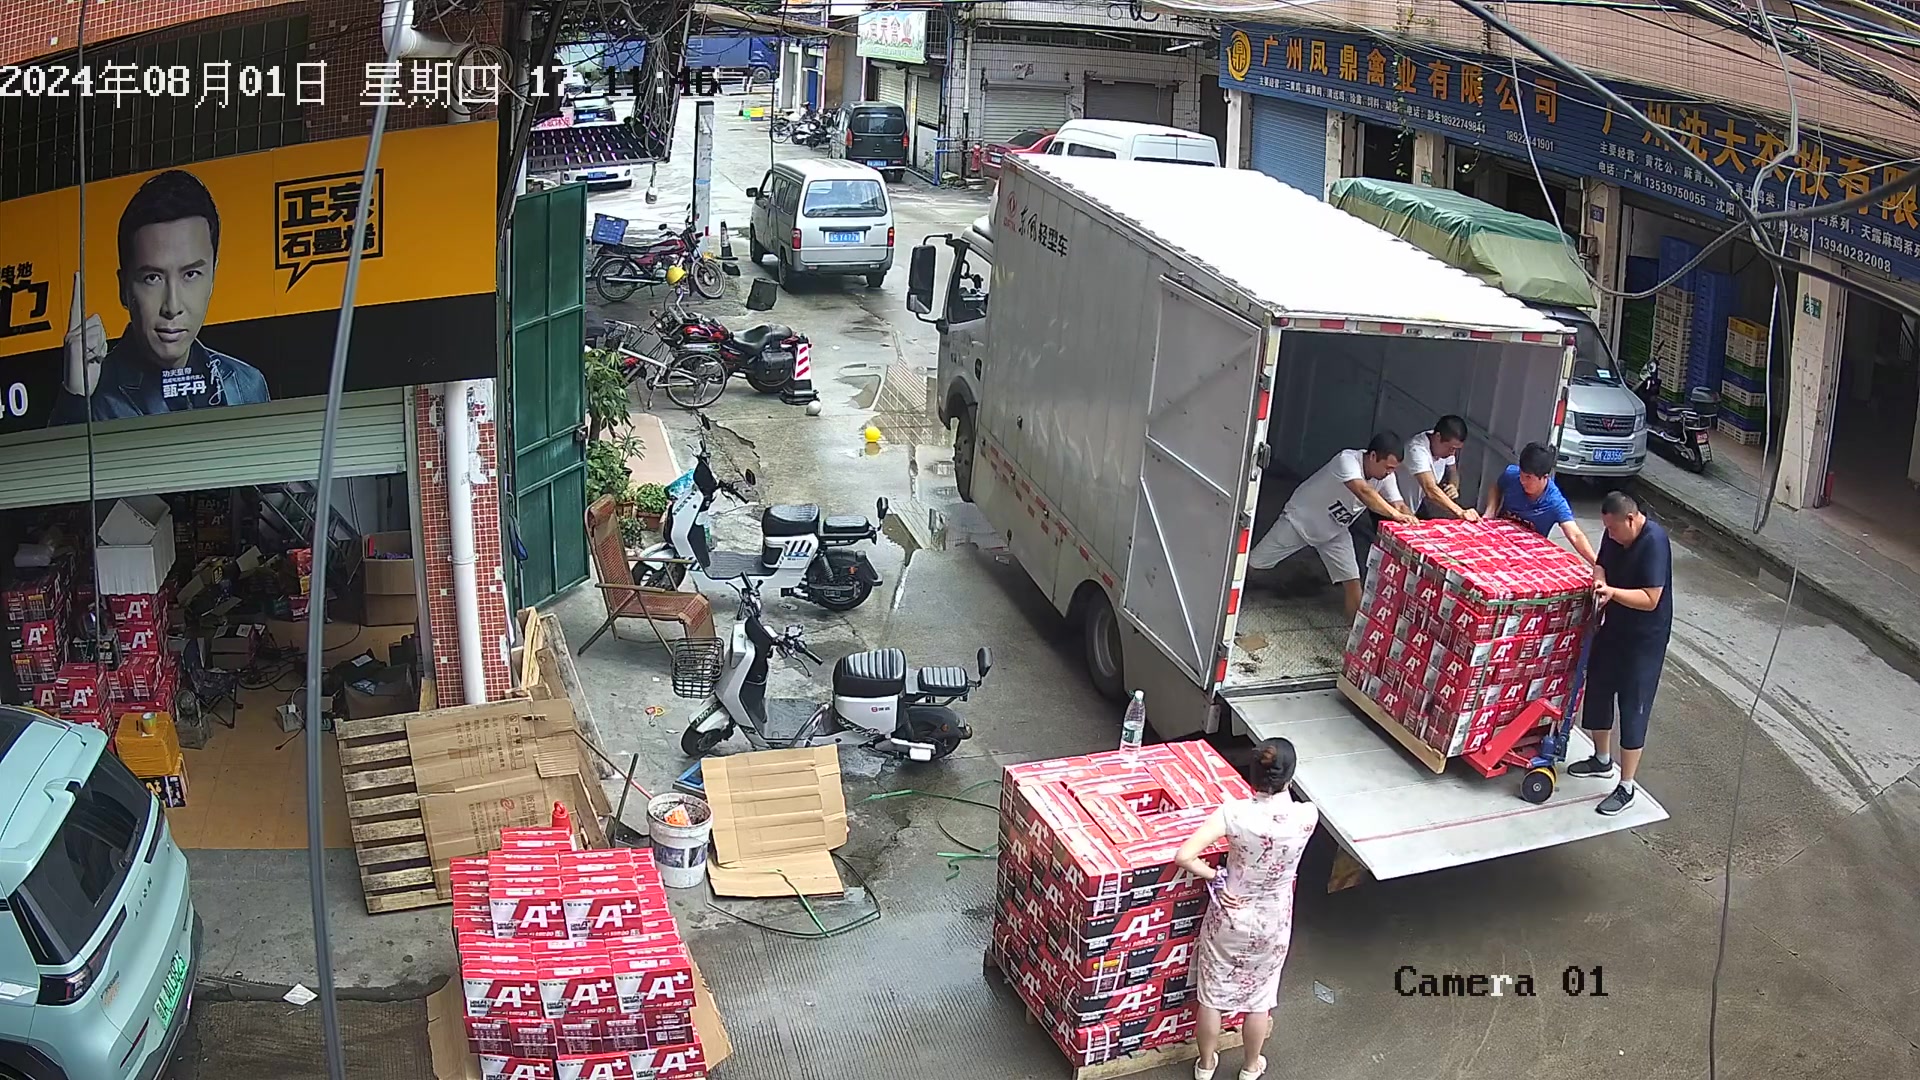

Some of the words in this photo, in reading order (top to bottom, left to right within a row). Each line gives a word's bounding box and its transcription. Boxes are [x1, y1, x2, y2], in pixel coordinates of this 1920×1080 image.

[282, 182, 374, 228] 正宗
[1645, 177, 1706, 206] 13539750055
[1819, 236, 1891, 273] 13940282008
[163, 380, 207, 399] 甄子丹
[1385, 562, 1400, 577] A+
[1382, 584, 1397, 599] A+
[1421, 587, 1437, 602] A+
[127, 598, 148, 618] A+
[1377, 606, 1391, 621] A+
[1457, 612, 1473, 628] A+
[1524, 615, 1542, 631] A+
[28, 624, 47, 645] A+
[132, 629, 153, 648] A+
[1369, 630, 1384, 644] A+
[1412, 632, 1428, 647] A+
[1559, 633, 1576, 648] A+
[1362, 649, 1376, 663] A+
[1494, 642, 1512, 659] A+
[1405, 656, 1420, 671] A+
[1447, 661, 1462, 676] A+
[1440, 684, 1456, 699] A+
[1505, 683, 1523, 699] A+
[1547, 677, 1563, 692] A+
[73, 685, 93, 707] A+
[1384, 692, 1398, 707] A+
[1476, 710, 1494, 726] A+
[1470, 732, 1488, 748] A+
[1029, 819, 1048, 840] A+
[1011, 837, 1027, 862] A+
[1066, 863, 1084, 890] A+
[1046, 883, 1064, 909] A+
[520, 901, 562, 928] A+
[594, 900, 637, 928] A+
[1028, 898, 1044, 924] A+
[1008, 911, 1023, 935] A+
[1120, 908, 1164, 941] A+
[1062, 941, 1082, 971] A+
[1041, 956, 1058, 984] A+
[570, 978, 612, 1007] A+
[646, 971, 689, 1000] A+
[1023, 970, 1041, 995] A+
[494, 983, 536, 1008] A+
[1114, 984, 1157, 1015] A+
[1058, 1017, 1076, 1042] A+
[1152, 1009, 1193, 1039] A+
[586, 1058, 627, 1080] A+
[661, 1047, 700, 1074] A+
[510, 1063, 551, 1080] A+
